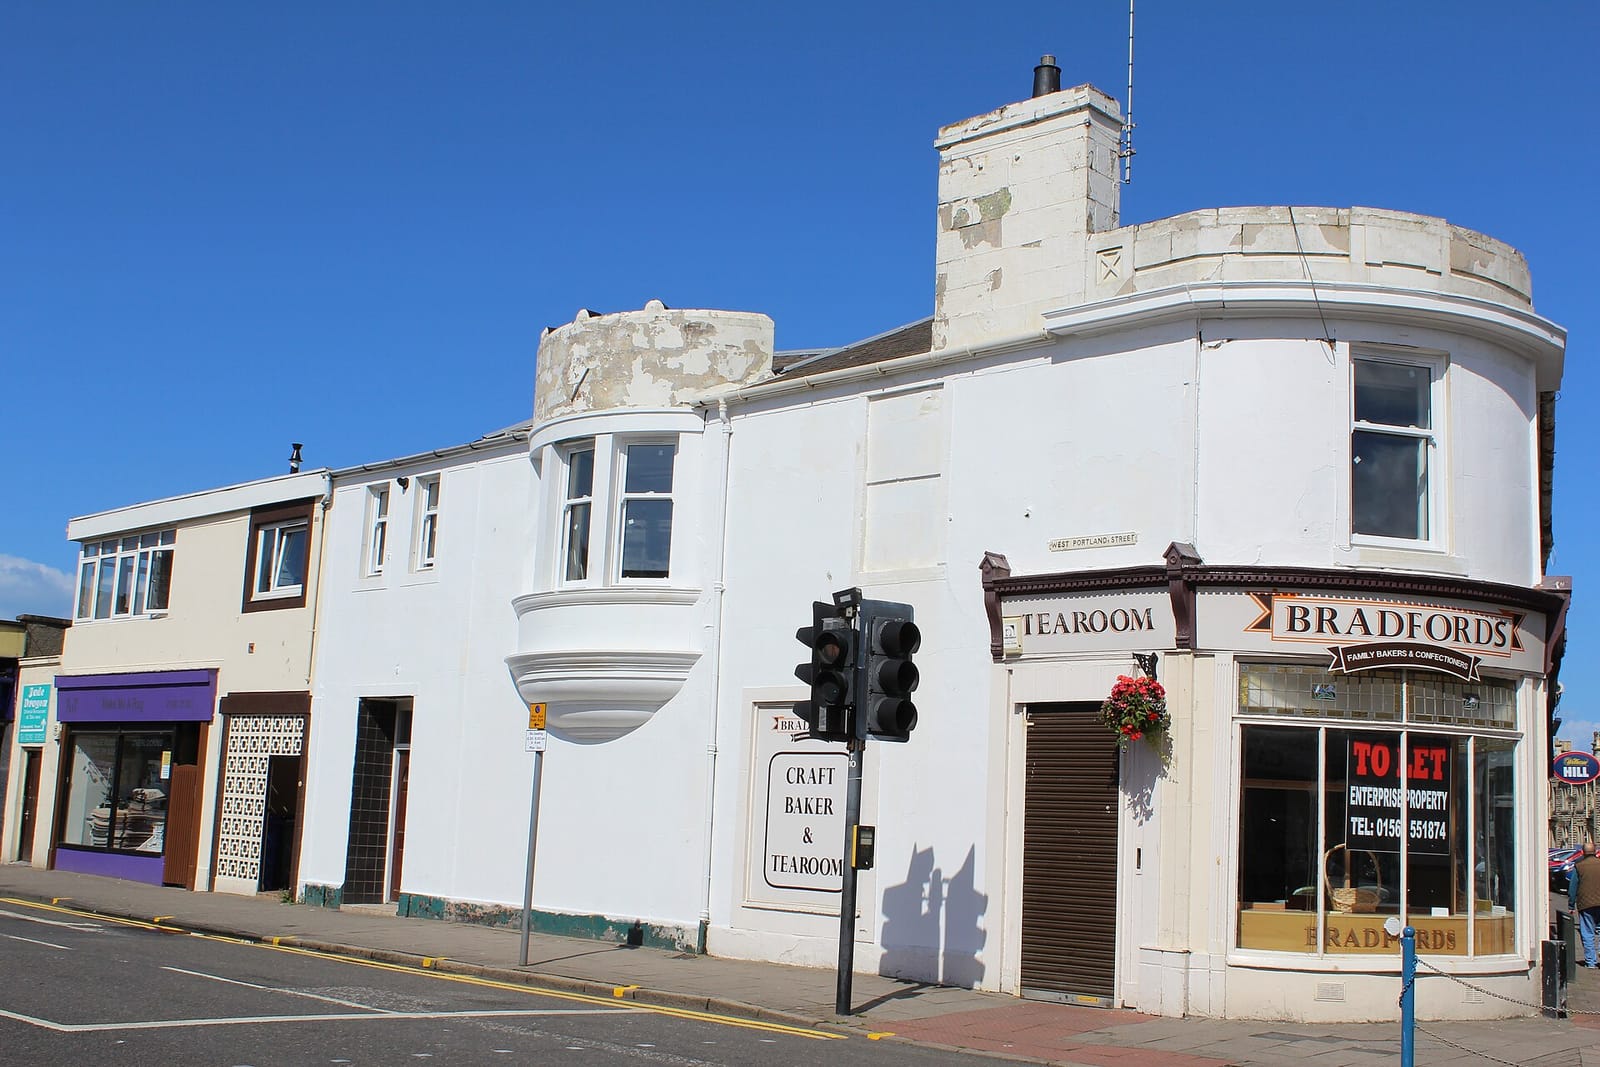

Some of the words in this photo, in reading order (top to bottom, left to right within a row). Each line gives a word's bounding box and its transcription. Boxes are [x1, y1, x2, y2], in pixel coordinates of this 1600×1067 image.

[1052, 540, 1070, 548] WEST
[1073, 537, 1107, 546] PORTLAND
[1111, 534, 1135, 543] STREET
[1022, 607, 1155, 636] TEAROOM
[1285, 604, 1507, 648] BRADFORDS
[1347, 651, 1375, 662] FAMILY
[1376, 650, 1407, 658] BAKERS
[1415, 651, 1468, 670] CONFECTIONERS
[781, 720, 810, 731] BRAD
[1353, 741, 1391, 777] TO
[786, 766, 836, 785] CRAFT
[1563, 766, 1589, 778] HILL
[784, 796, 834, 815] BAKER
[1350, 785, 1401, 808] ENTERPRISE
[802, 826, 813, 844] &
[1350, 816, 1374, 836] TEL:
[1376, 818, 1402, 838] 0156
[1409, 819, 1447, 840] 551874
[771, 854, 843, 877] TEAROOM
[1304, 926, 1457, 951] BRADFRDS
